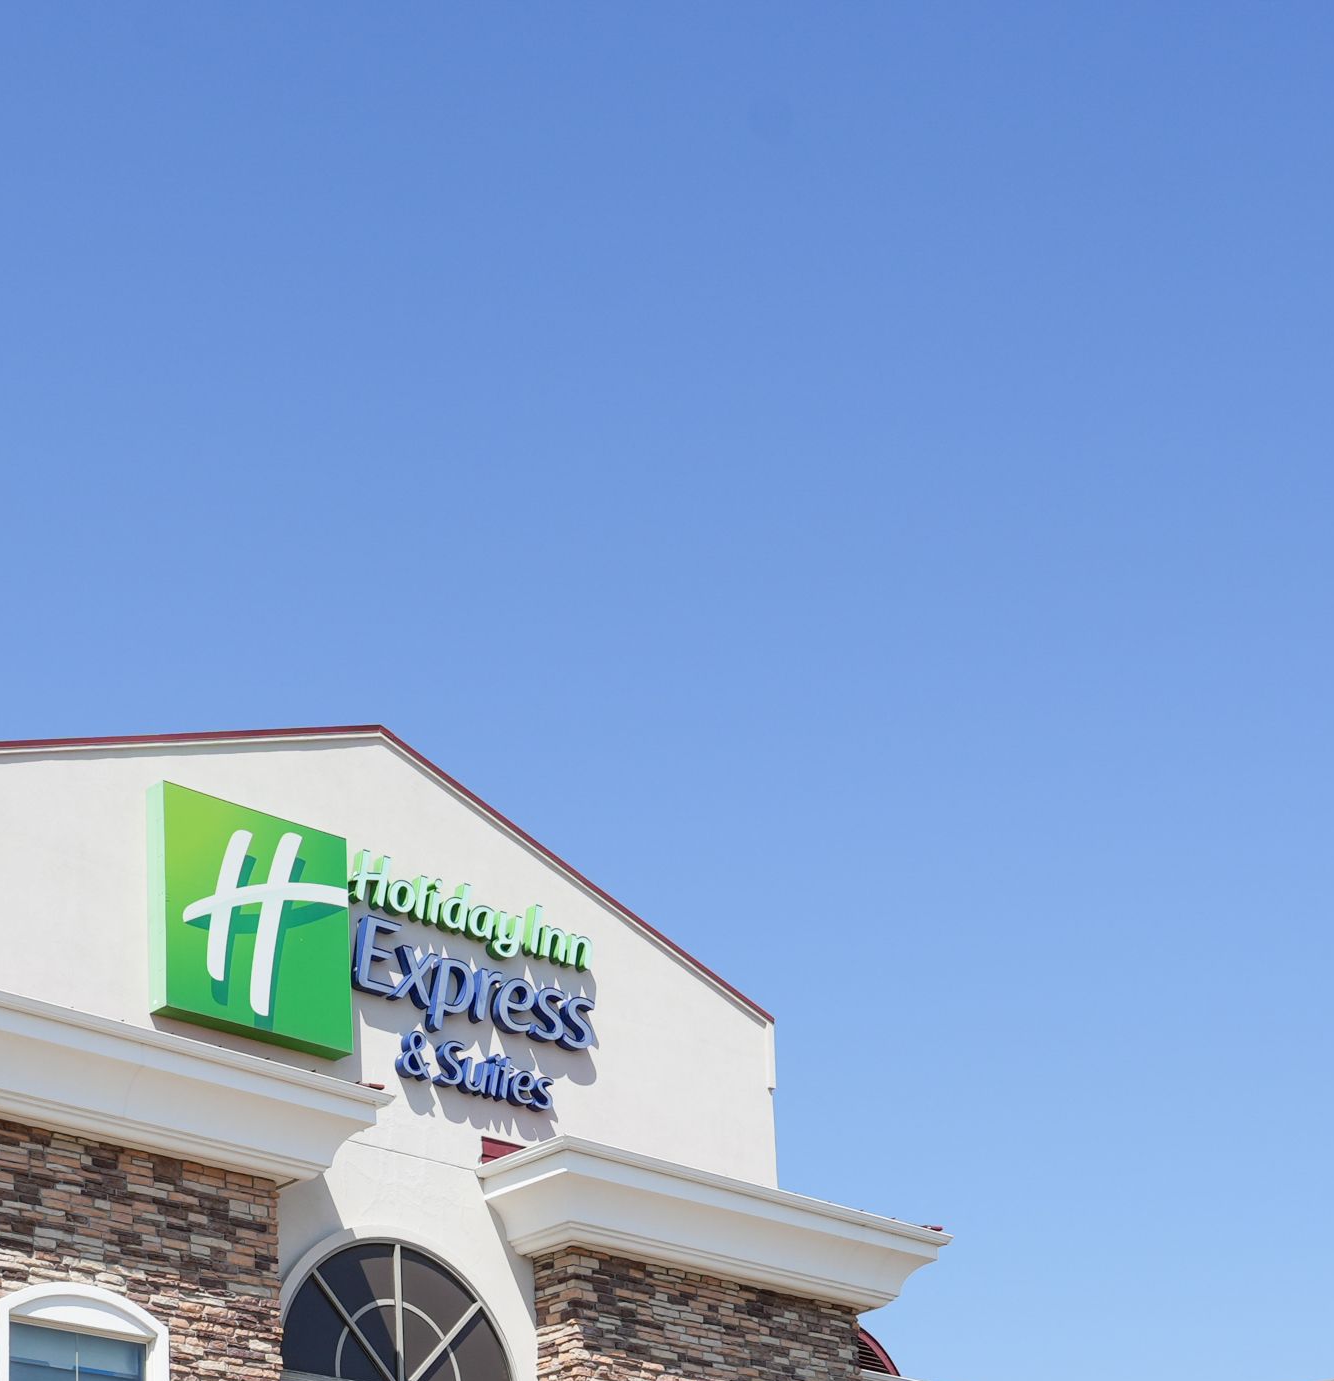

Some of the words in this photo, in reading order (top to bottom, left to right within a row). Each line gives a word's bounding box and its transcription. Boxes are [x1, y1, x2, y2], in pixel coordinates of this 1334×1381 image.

[183, 829, 348, 1016] H
[349, 849, 522, 959] Holiday
[524, 904, 593, 972] Inn
[353, 914, 595, 1050] Express
[396, 1030, 431, 1081] &
[432, 1040, 555, 1112] Suites
